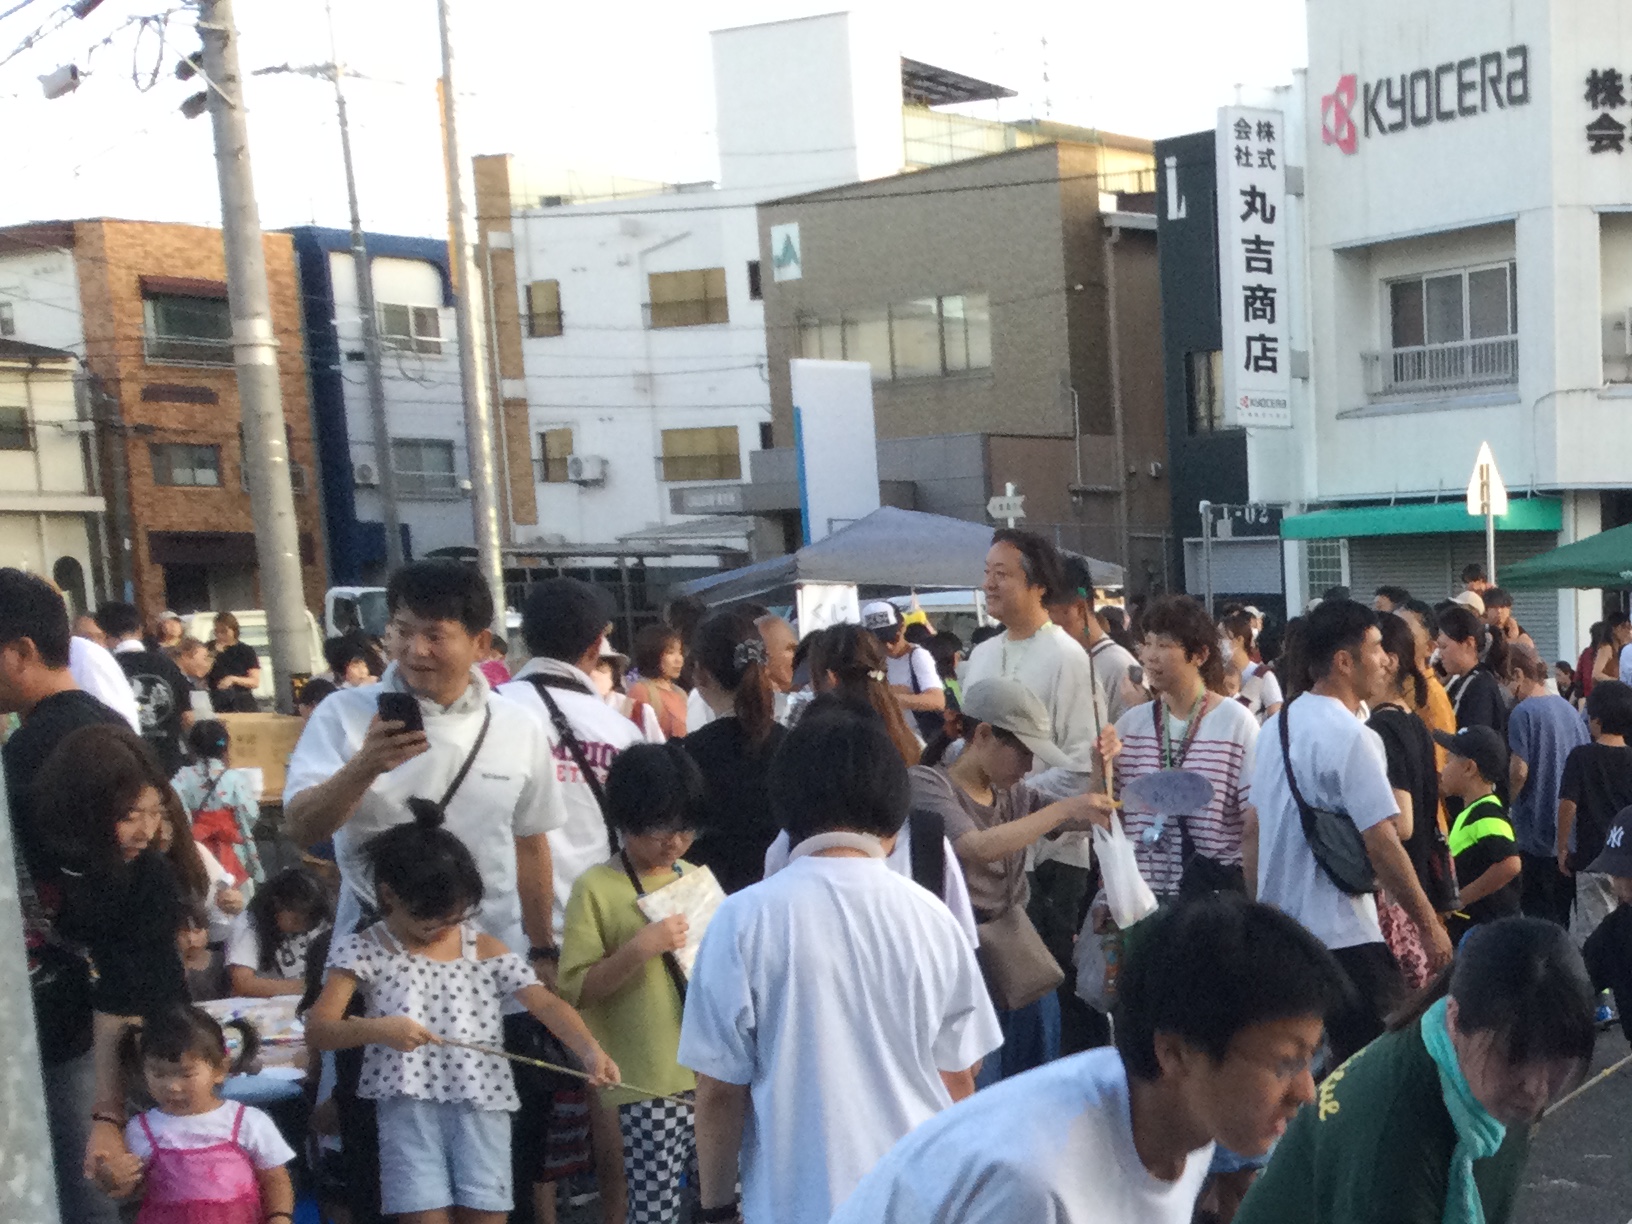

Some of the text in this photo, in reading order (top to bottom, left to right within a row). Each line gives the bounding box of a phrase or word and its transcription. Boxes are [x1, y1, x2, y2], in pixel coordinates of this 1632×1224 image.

[1363, 43, 1529, 138] KYOCERA
[1239, 184, 1278, 373] 丸吉商店
